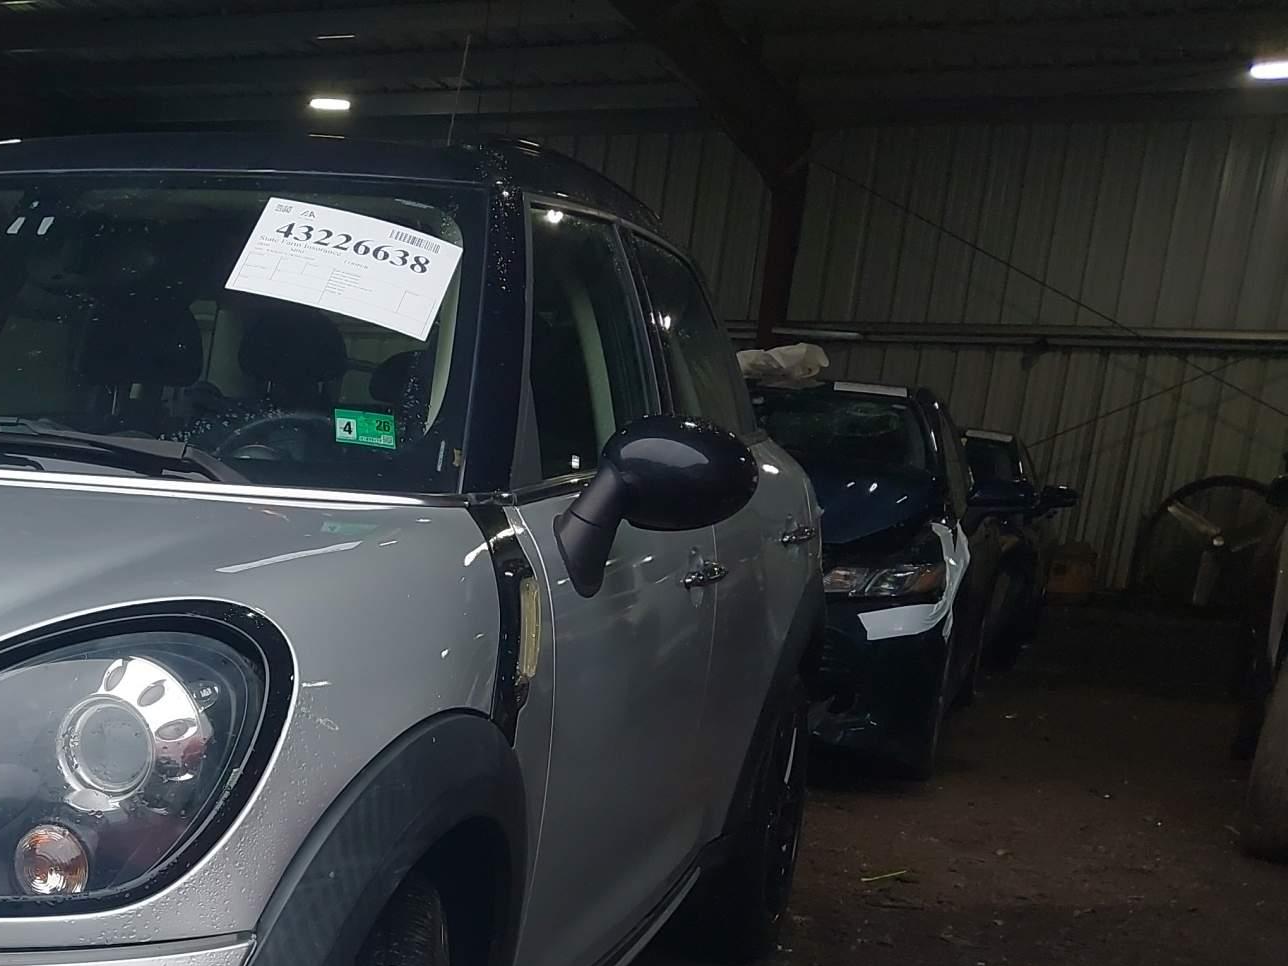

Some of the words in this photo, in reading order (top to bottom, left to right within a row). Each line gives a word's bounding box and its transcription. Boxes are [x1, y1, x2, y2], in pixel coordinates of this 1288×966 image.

[276, 221, 431, 274] 43226638
[343, 421, 352, 435] 4
[375, 419, 391, 432] 26
